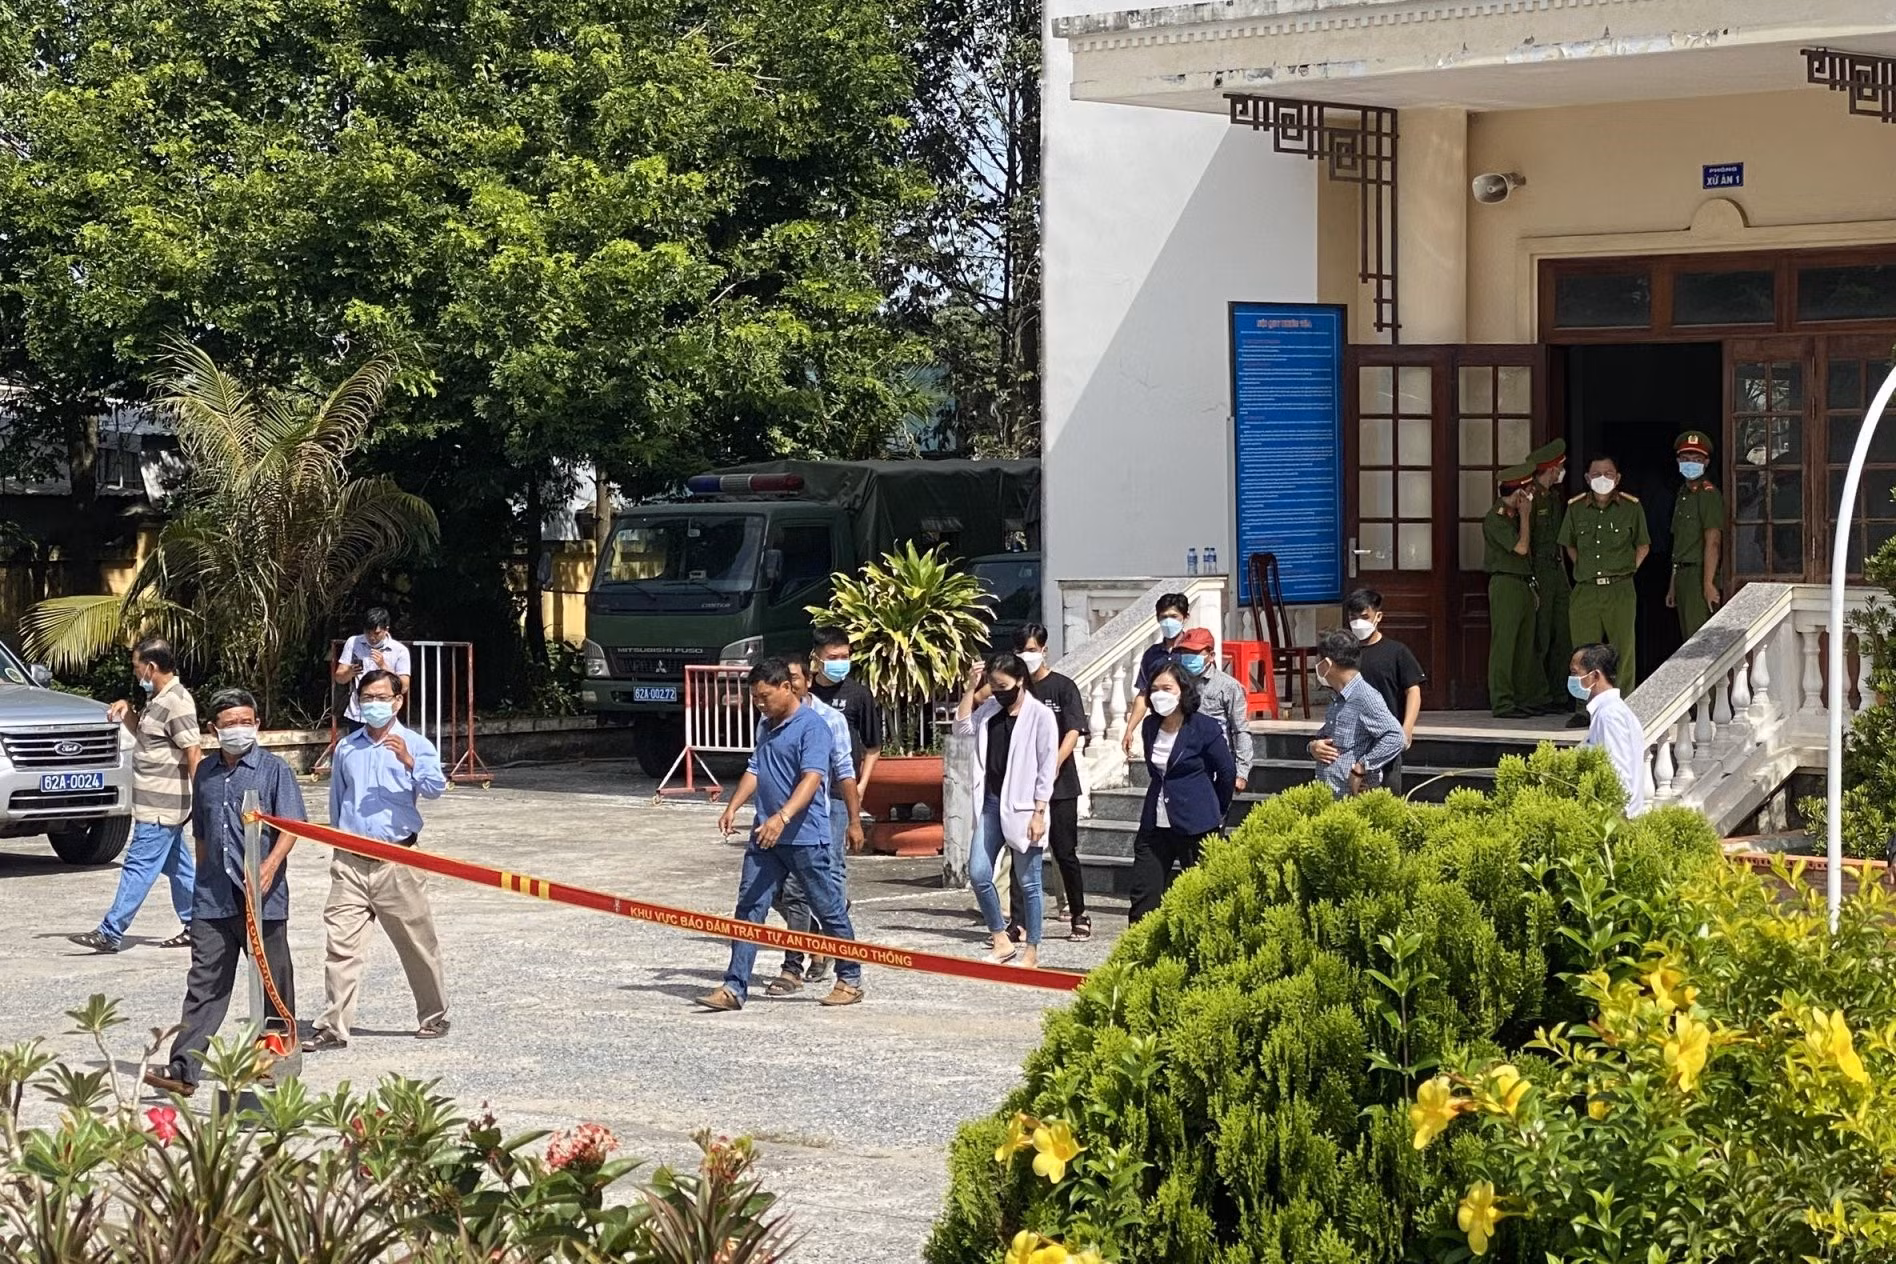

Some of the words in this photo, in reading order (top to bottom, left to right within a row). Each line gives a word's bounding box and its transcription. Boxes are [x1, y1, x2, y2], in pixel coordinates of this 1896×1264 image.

[1706, 174, 1720, 186] XỬ
[1720, 174, 1733, 185] ÁN
[1736, 175, 1740, 184] 1
[630, 906, 653, 920] KHU
[654, 911, 678, 925] VỰC
[786, 935, 803, 947] AN
[806, 937, 837, 953] TOÀN
[838, 944, 868, 959] GIAO
[871, 950, 913, 967] THÔNG
